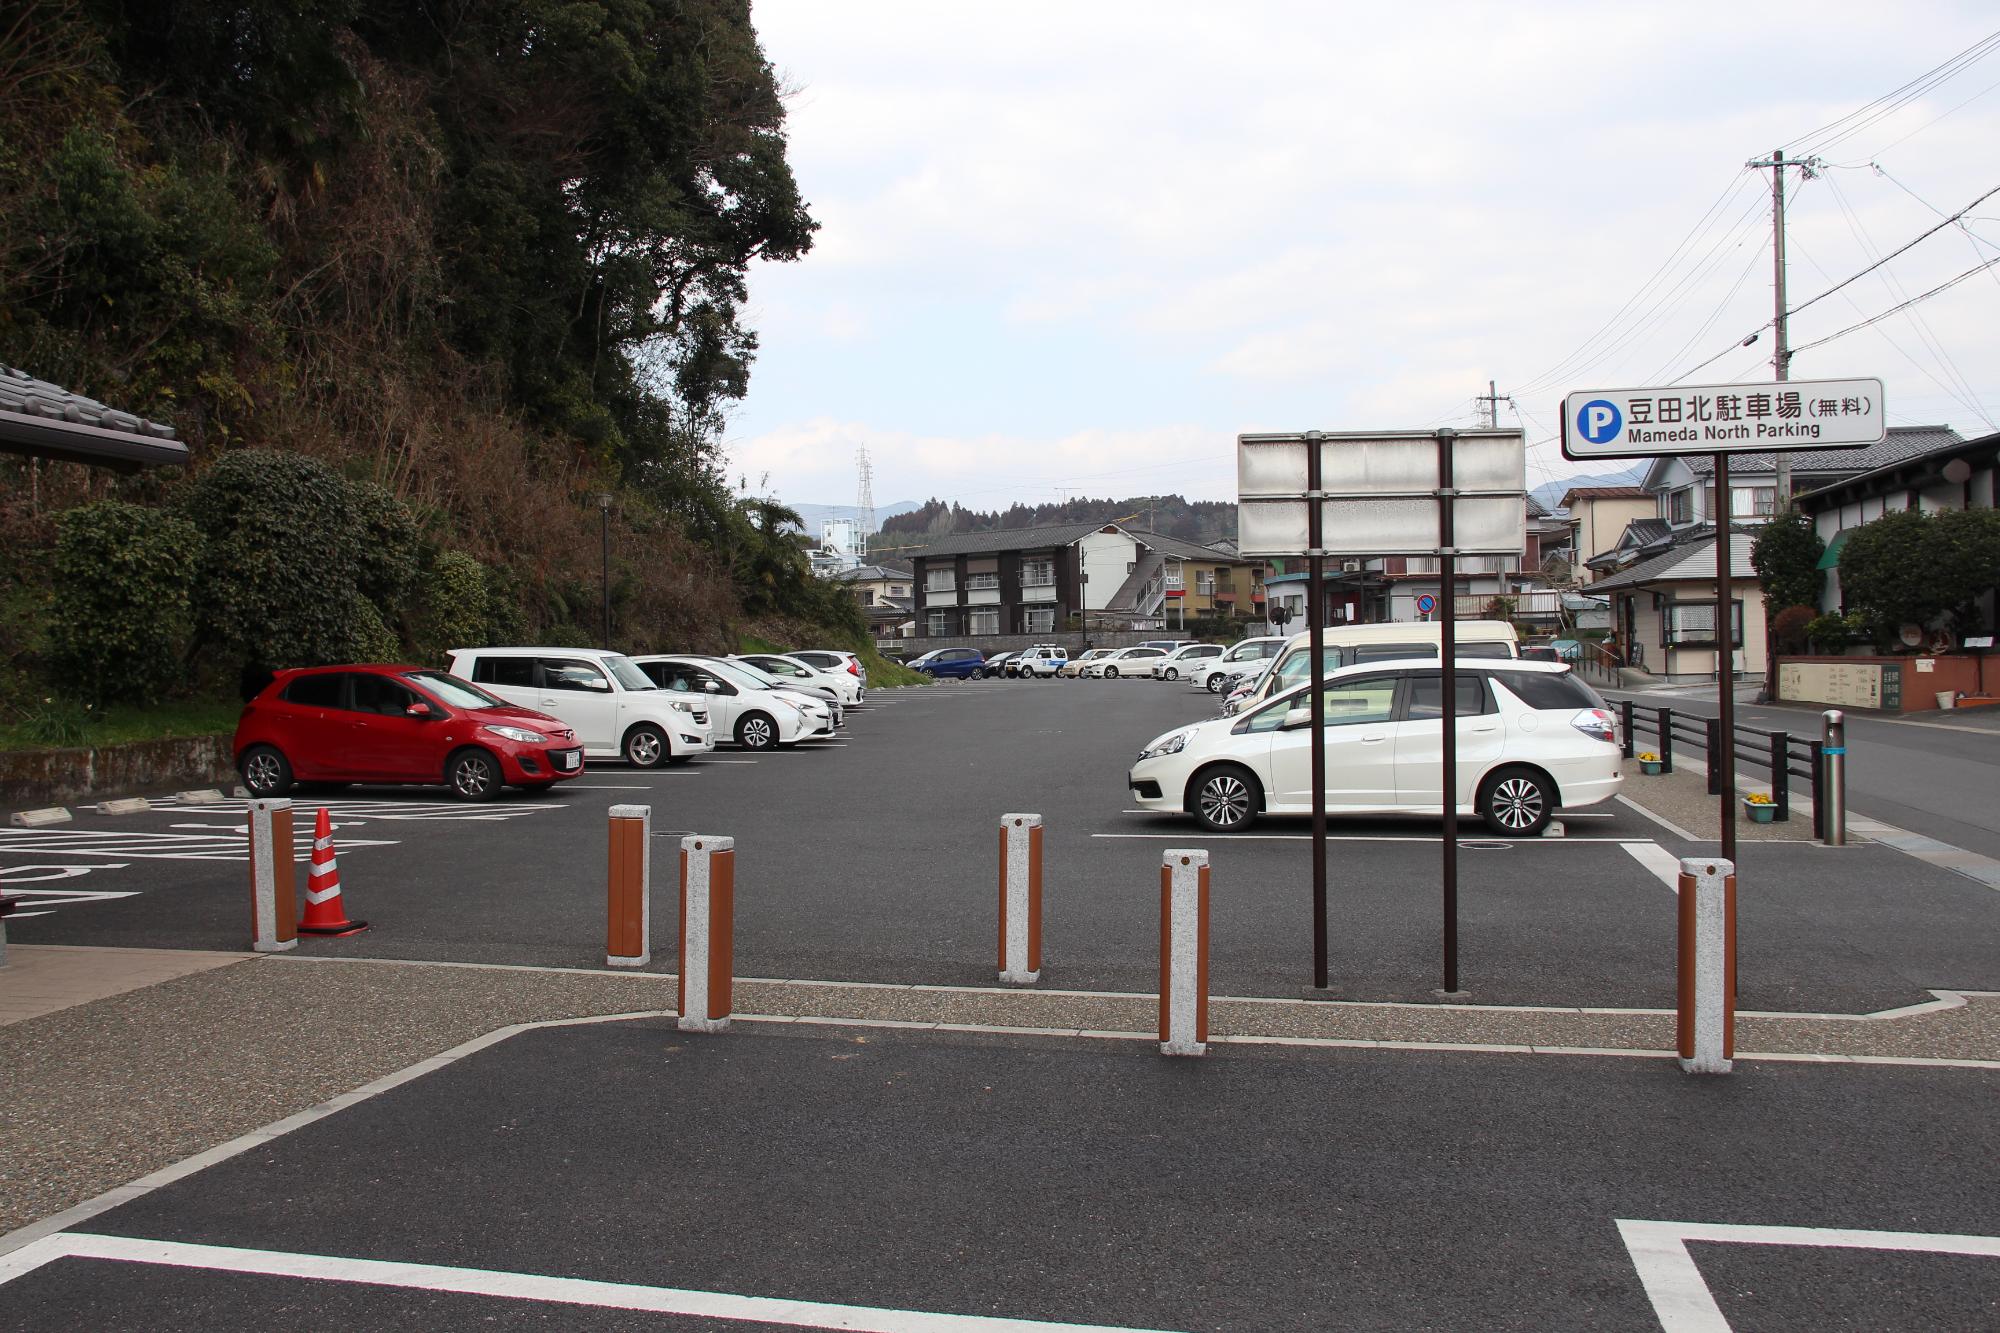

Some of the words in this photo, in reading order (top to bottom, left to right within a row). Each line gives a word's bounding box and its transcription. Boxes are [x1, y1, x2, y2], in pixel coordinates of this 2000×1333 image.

[1588, 406, 1614, 438] P
[1628, 426, 1698, 443] Mameda
[1704, 424, 1750, 440] North
[1757, 422, 1820, 439] Parking
